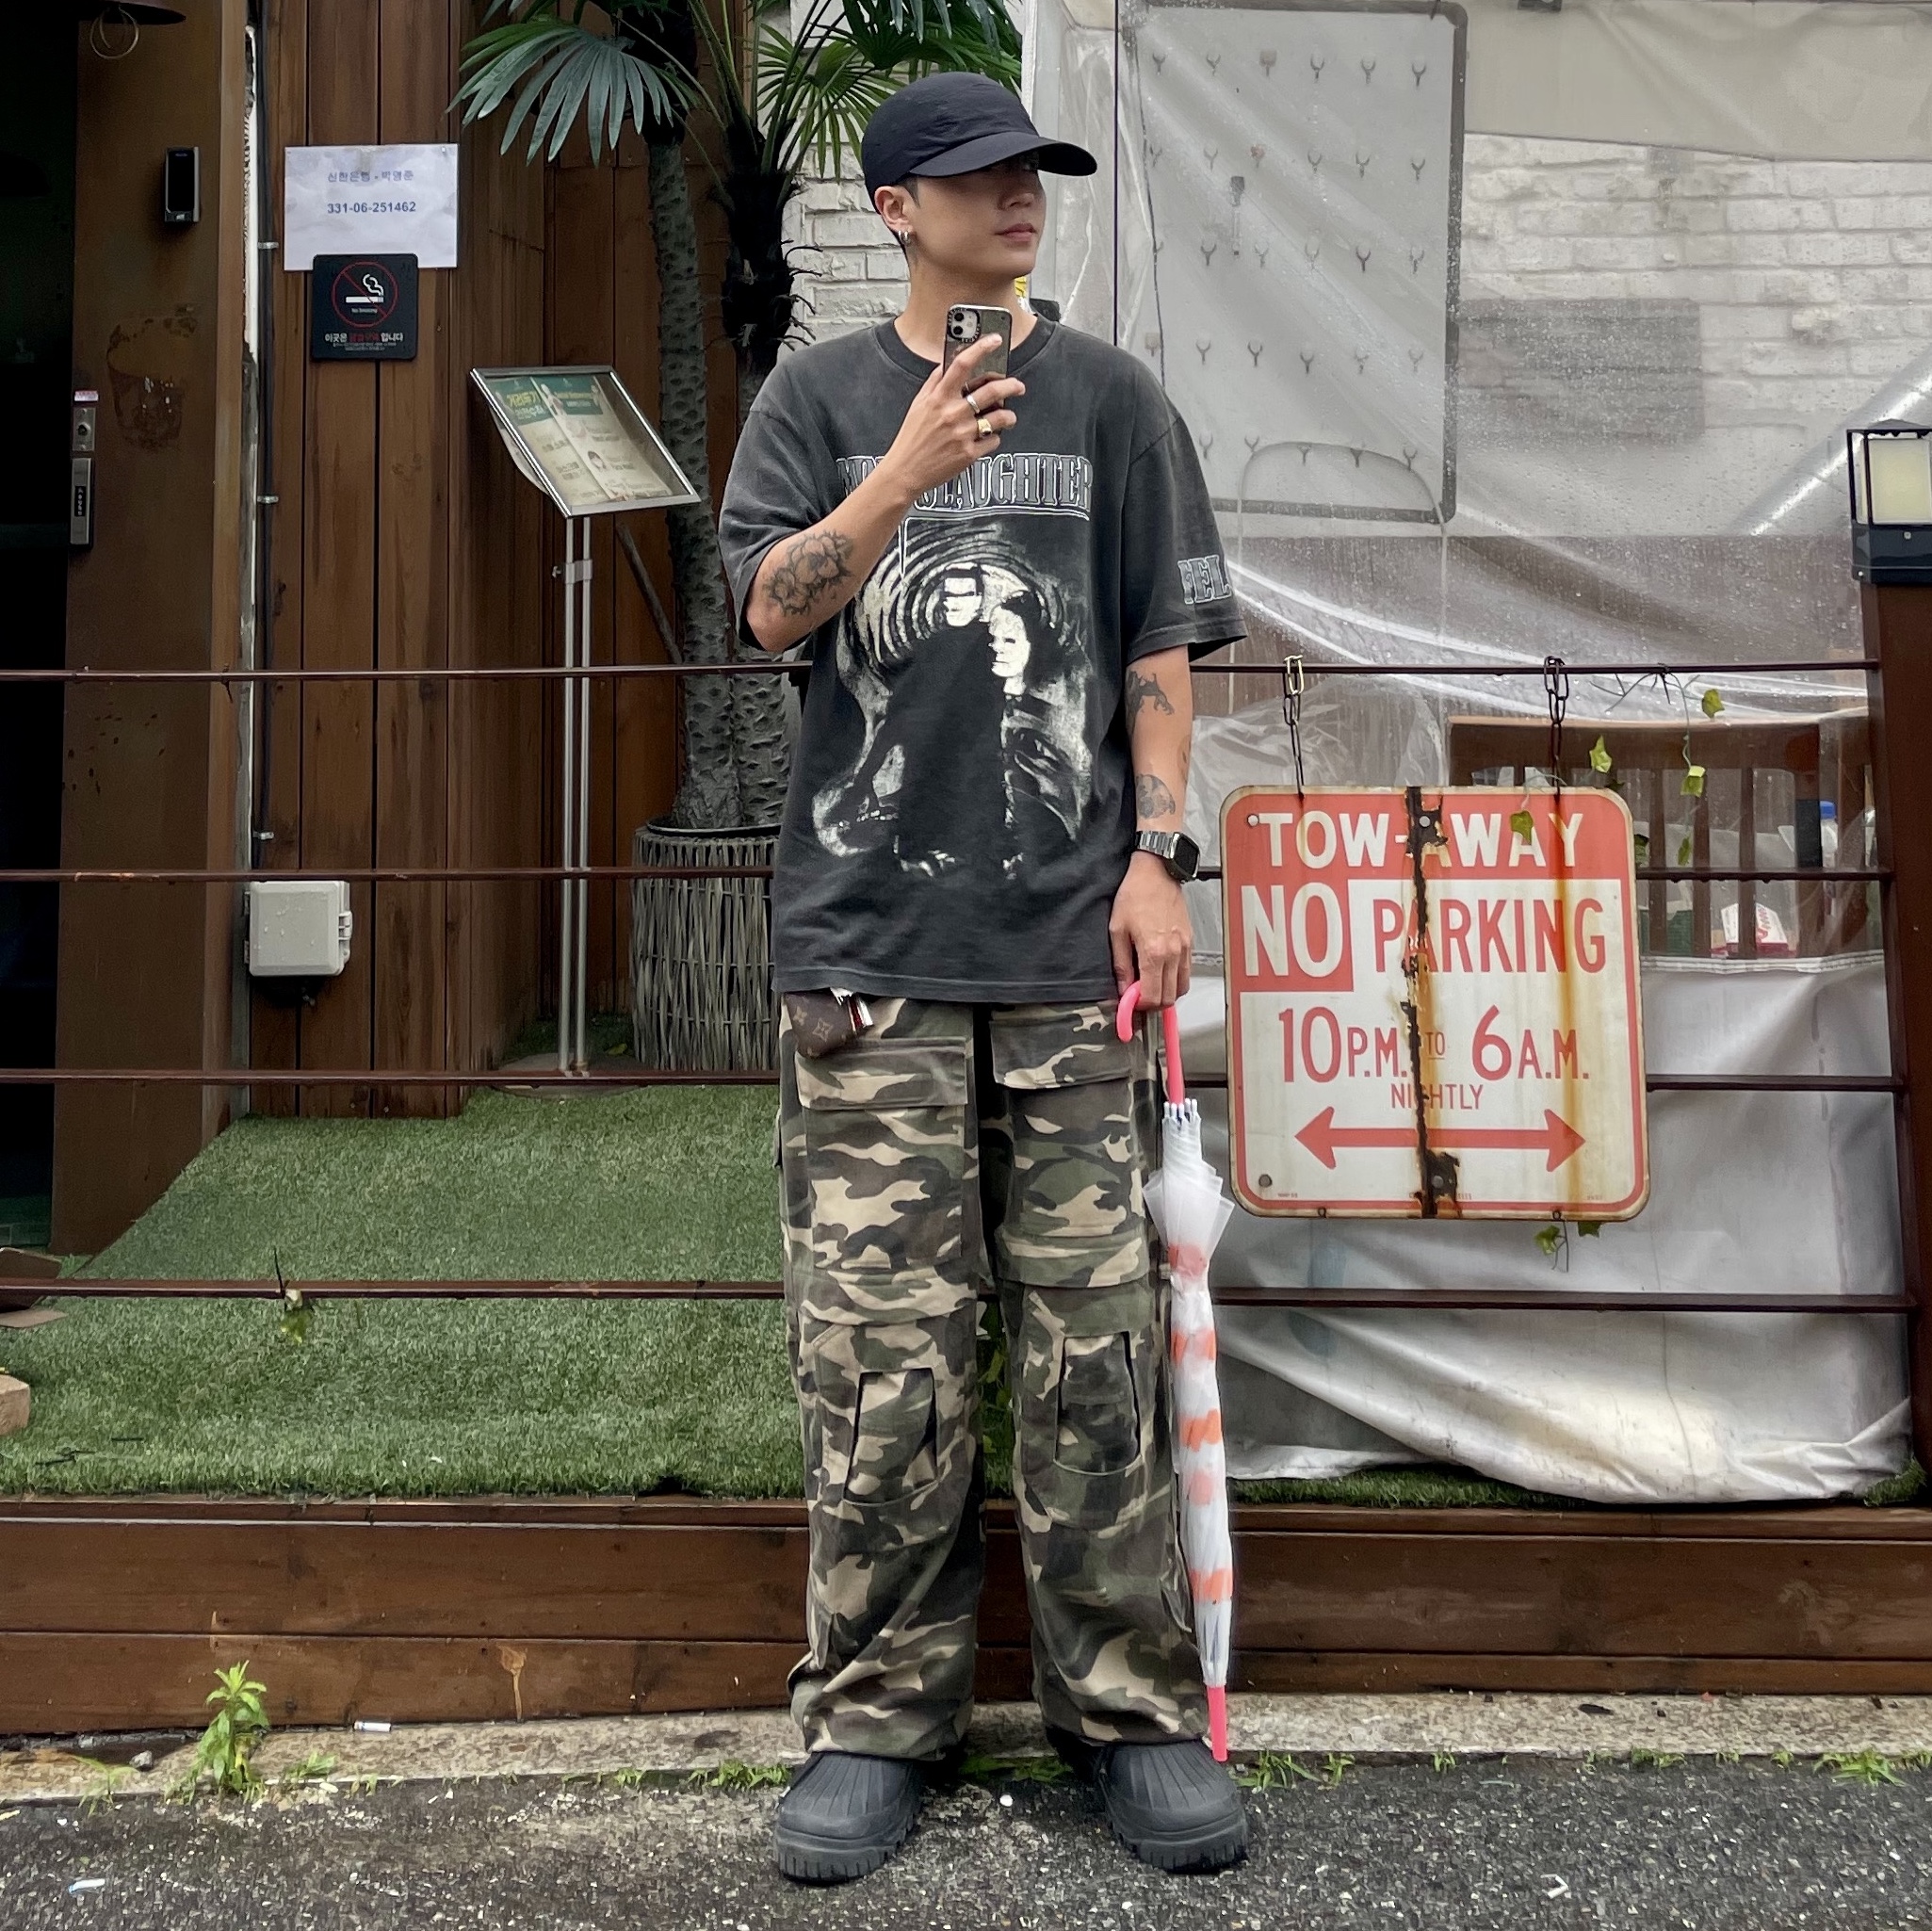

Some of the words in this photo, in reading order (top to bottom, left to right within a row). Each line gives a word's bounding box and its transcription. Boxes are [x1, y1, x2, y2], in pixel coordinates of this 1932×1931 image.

[327, 202, 416, 214] 331-06-251462
[1241, 882, 1343, 977] NO
[1372, 898, 1607, 973] PARKING
[1424, 1031, 1446, 1056] TO
[1390, 1083, 1484, 1110] NIHTLY
